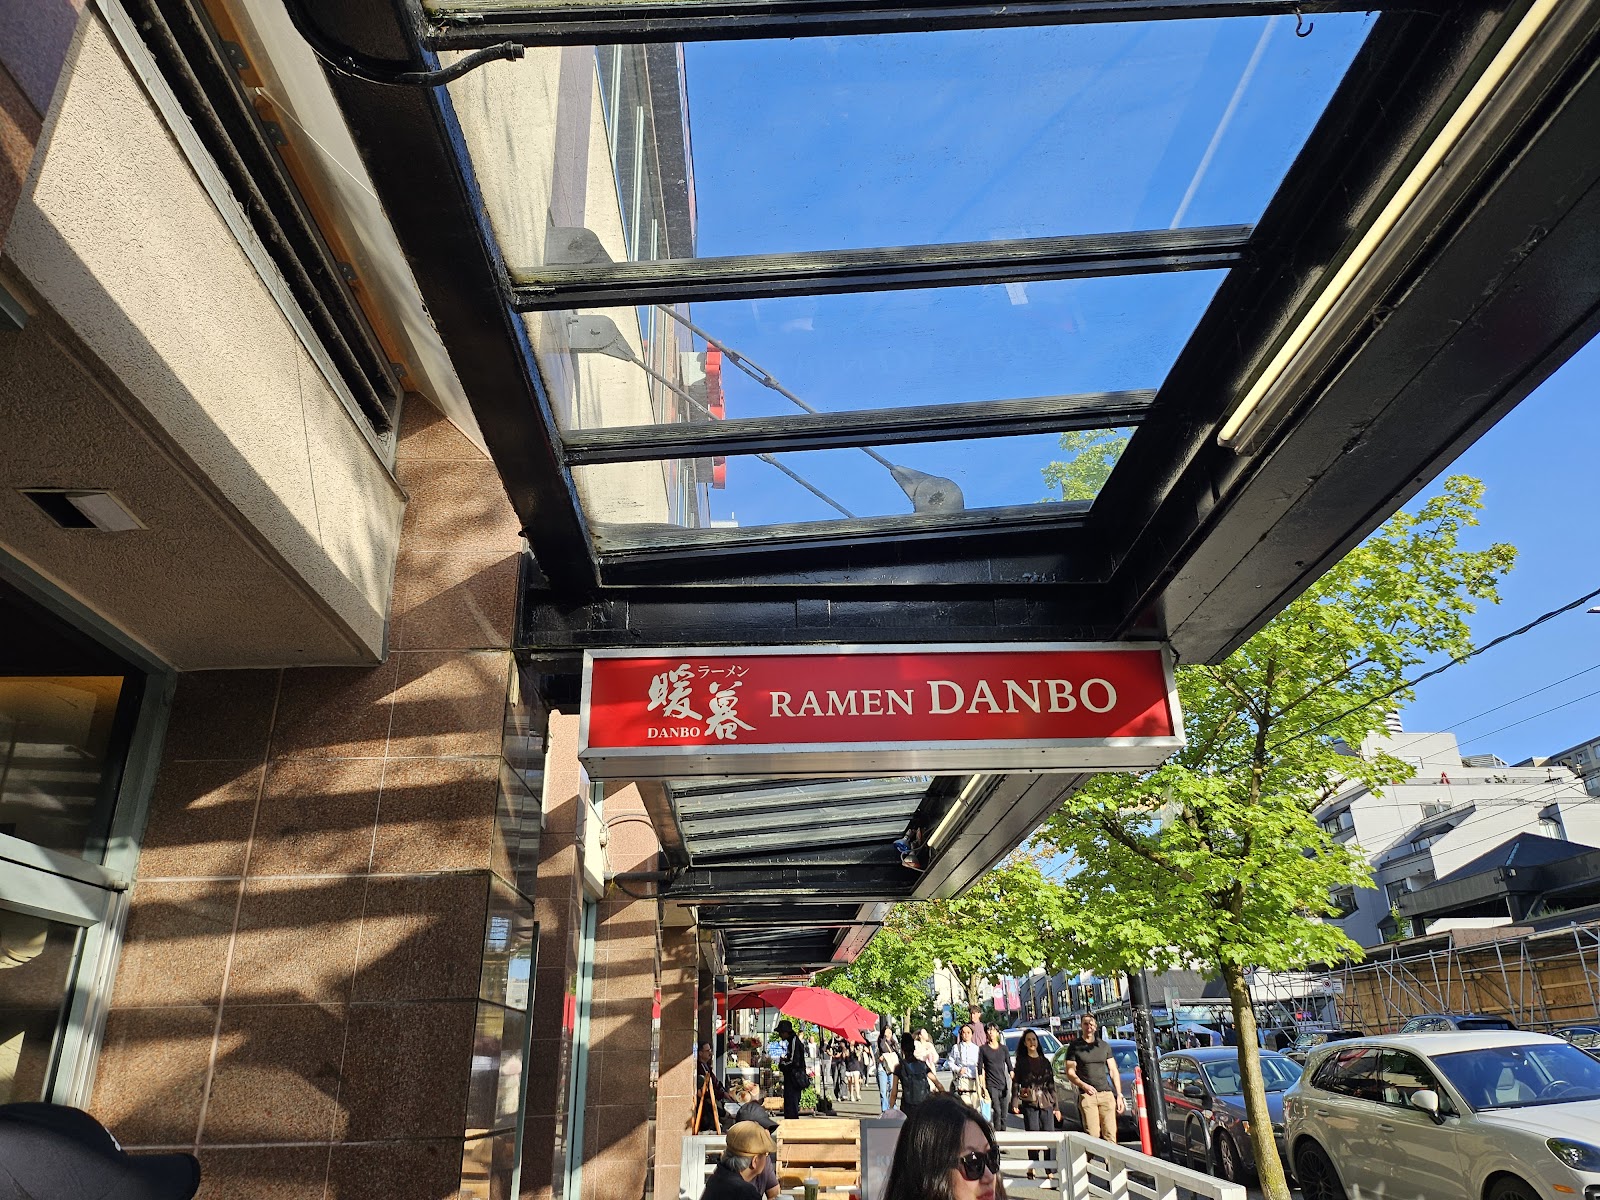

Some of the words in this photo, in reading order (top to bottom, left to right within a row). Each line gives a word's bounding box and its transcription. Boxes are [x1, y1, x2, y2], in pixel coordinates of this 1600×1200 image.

[697, 664, 750, 679] ラーメン
[769, 689, 915, 718] RAMEN
[926, 678, 1117, 715] DANBO
[647, 726, 701, 739] DANBO
